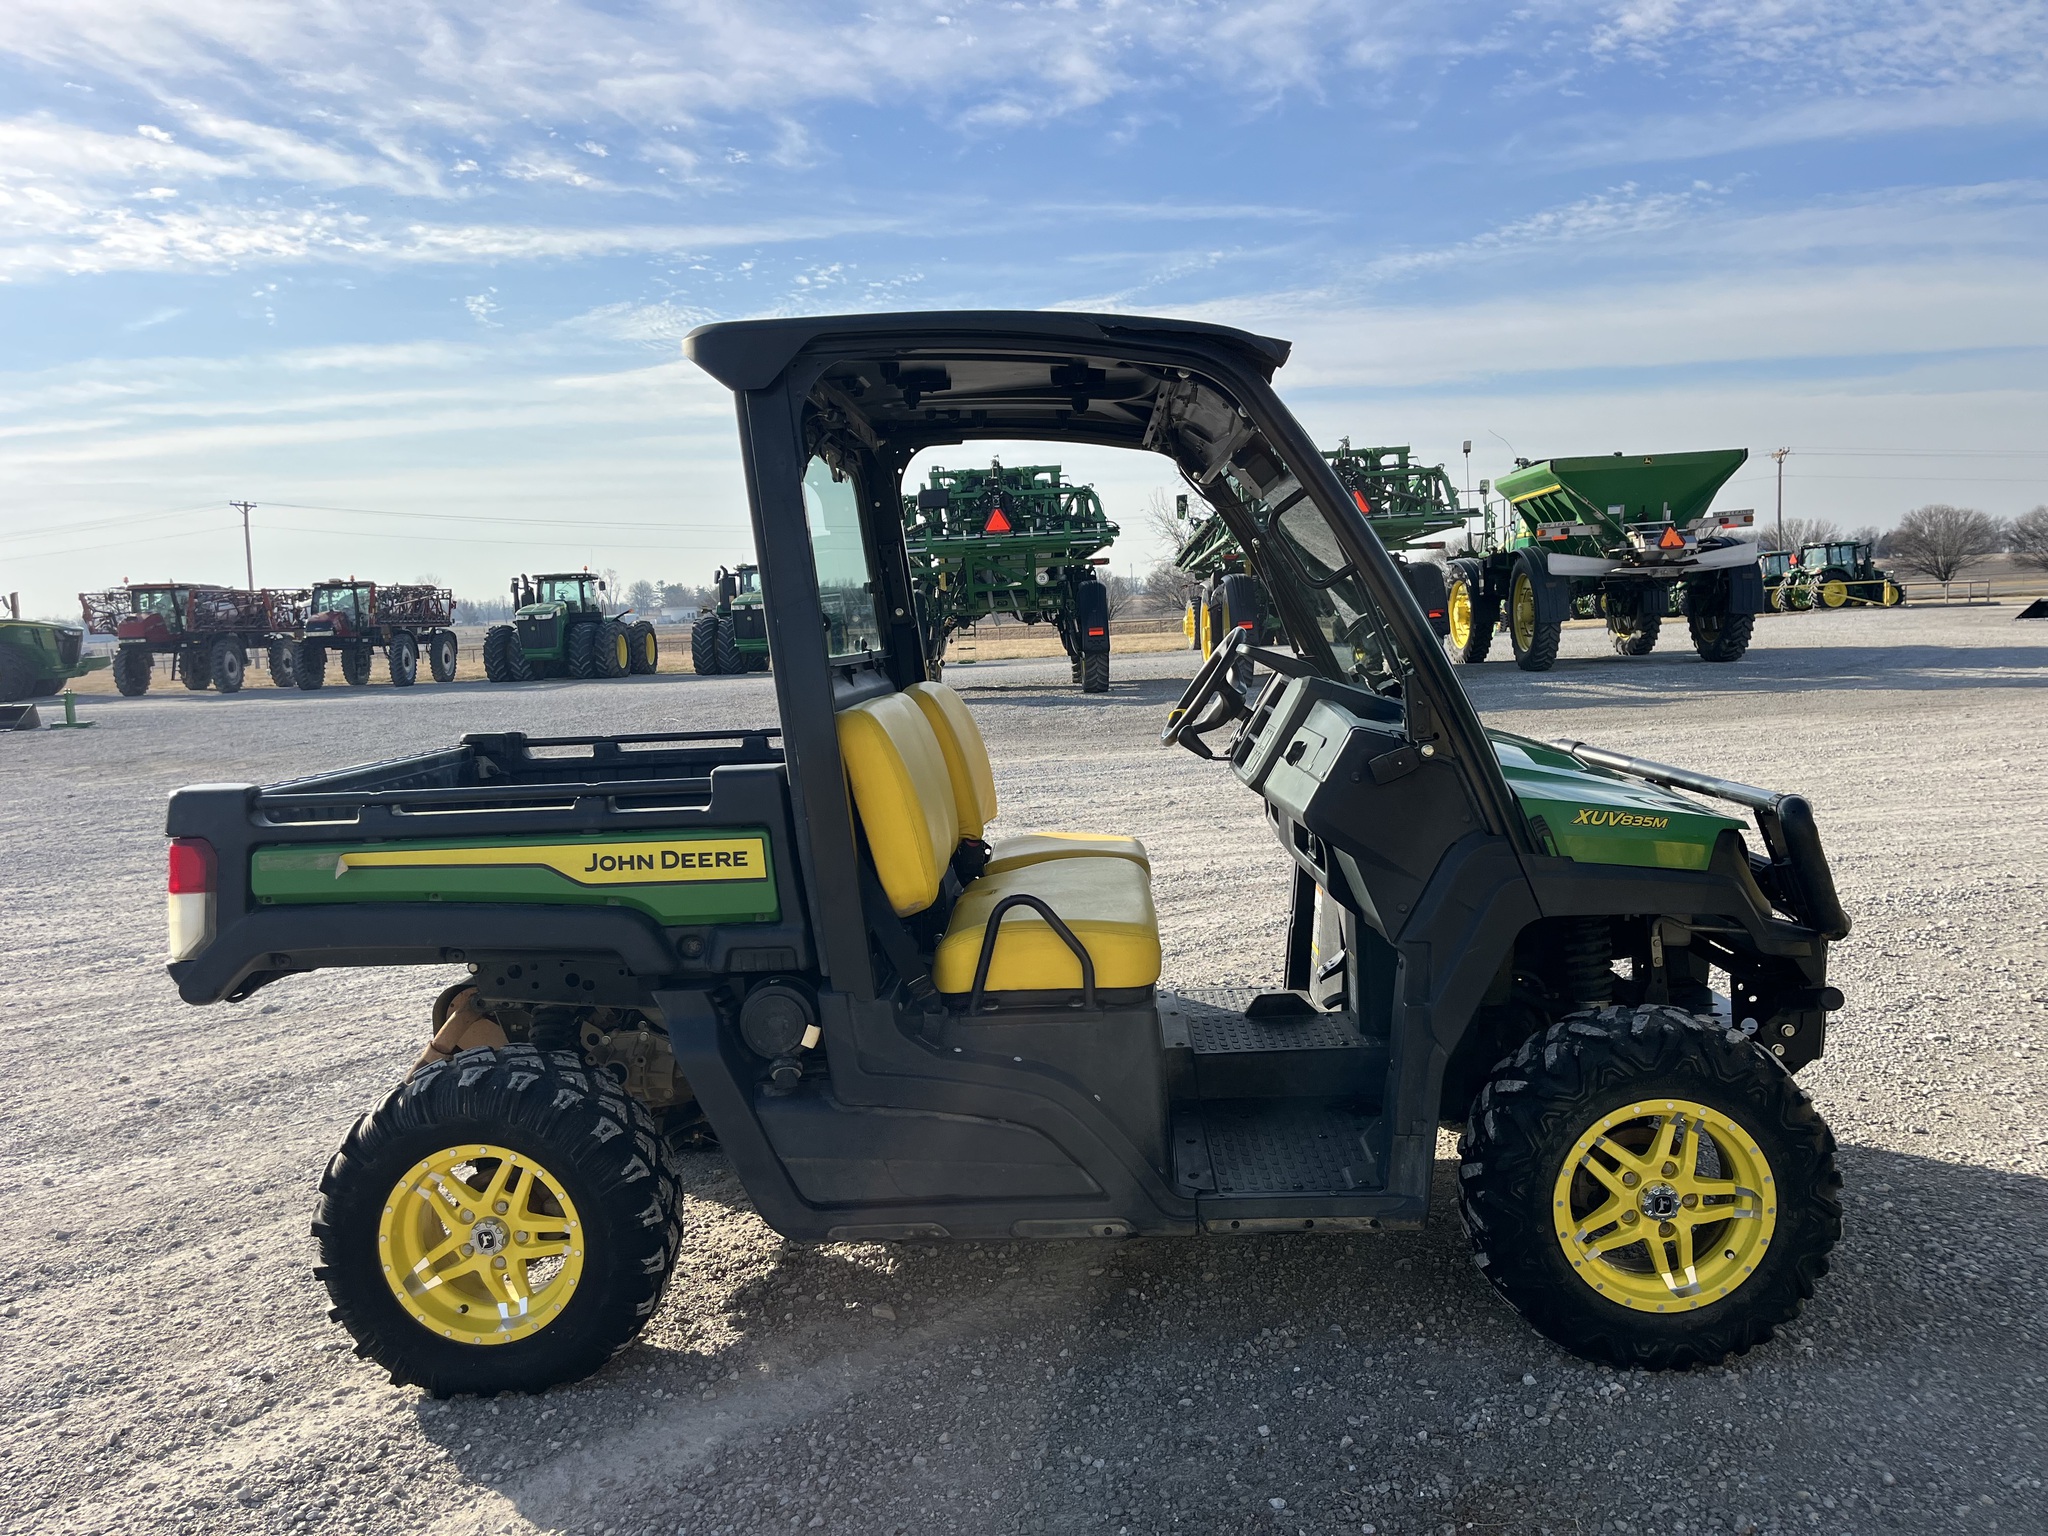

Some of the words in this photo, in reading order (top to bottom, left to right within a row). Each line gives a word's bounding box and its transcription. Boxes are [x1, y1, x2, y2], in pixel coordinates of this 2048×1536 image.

[1572, 809, 1669, 828] XUV835M
[584, 853, 654, 872] JOHN
[661, 850, 748, 869] DEERE
